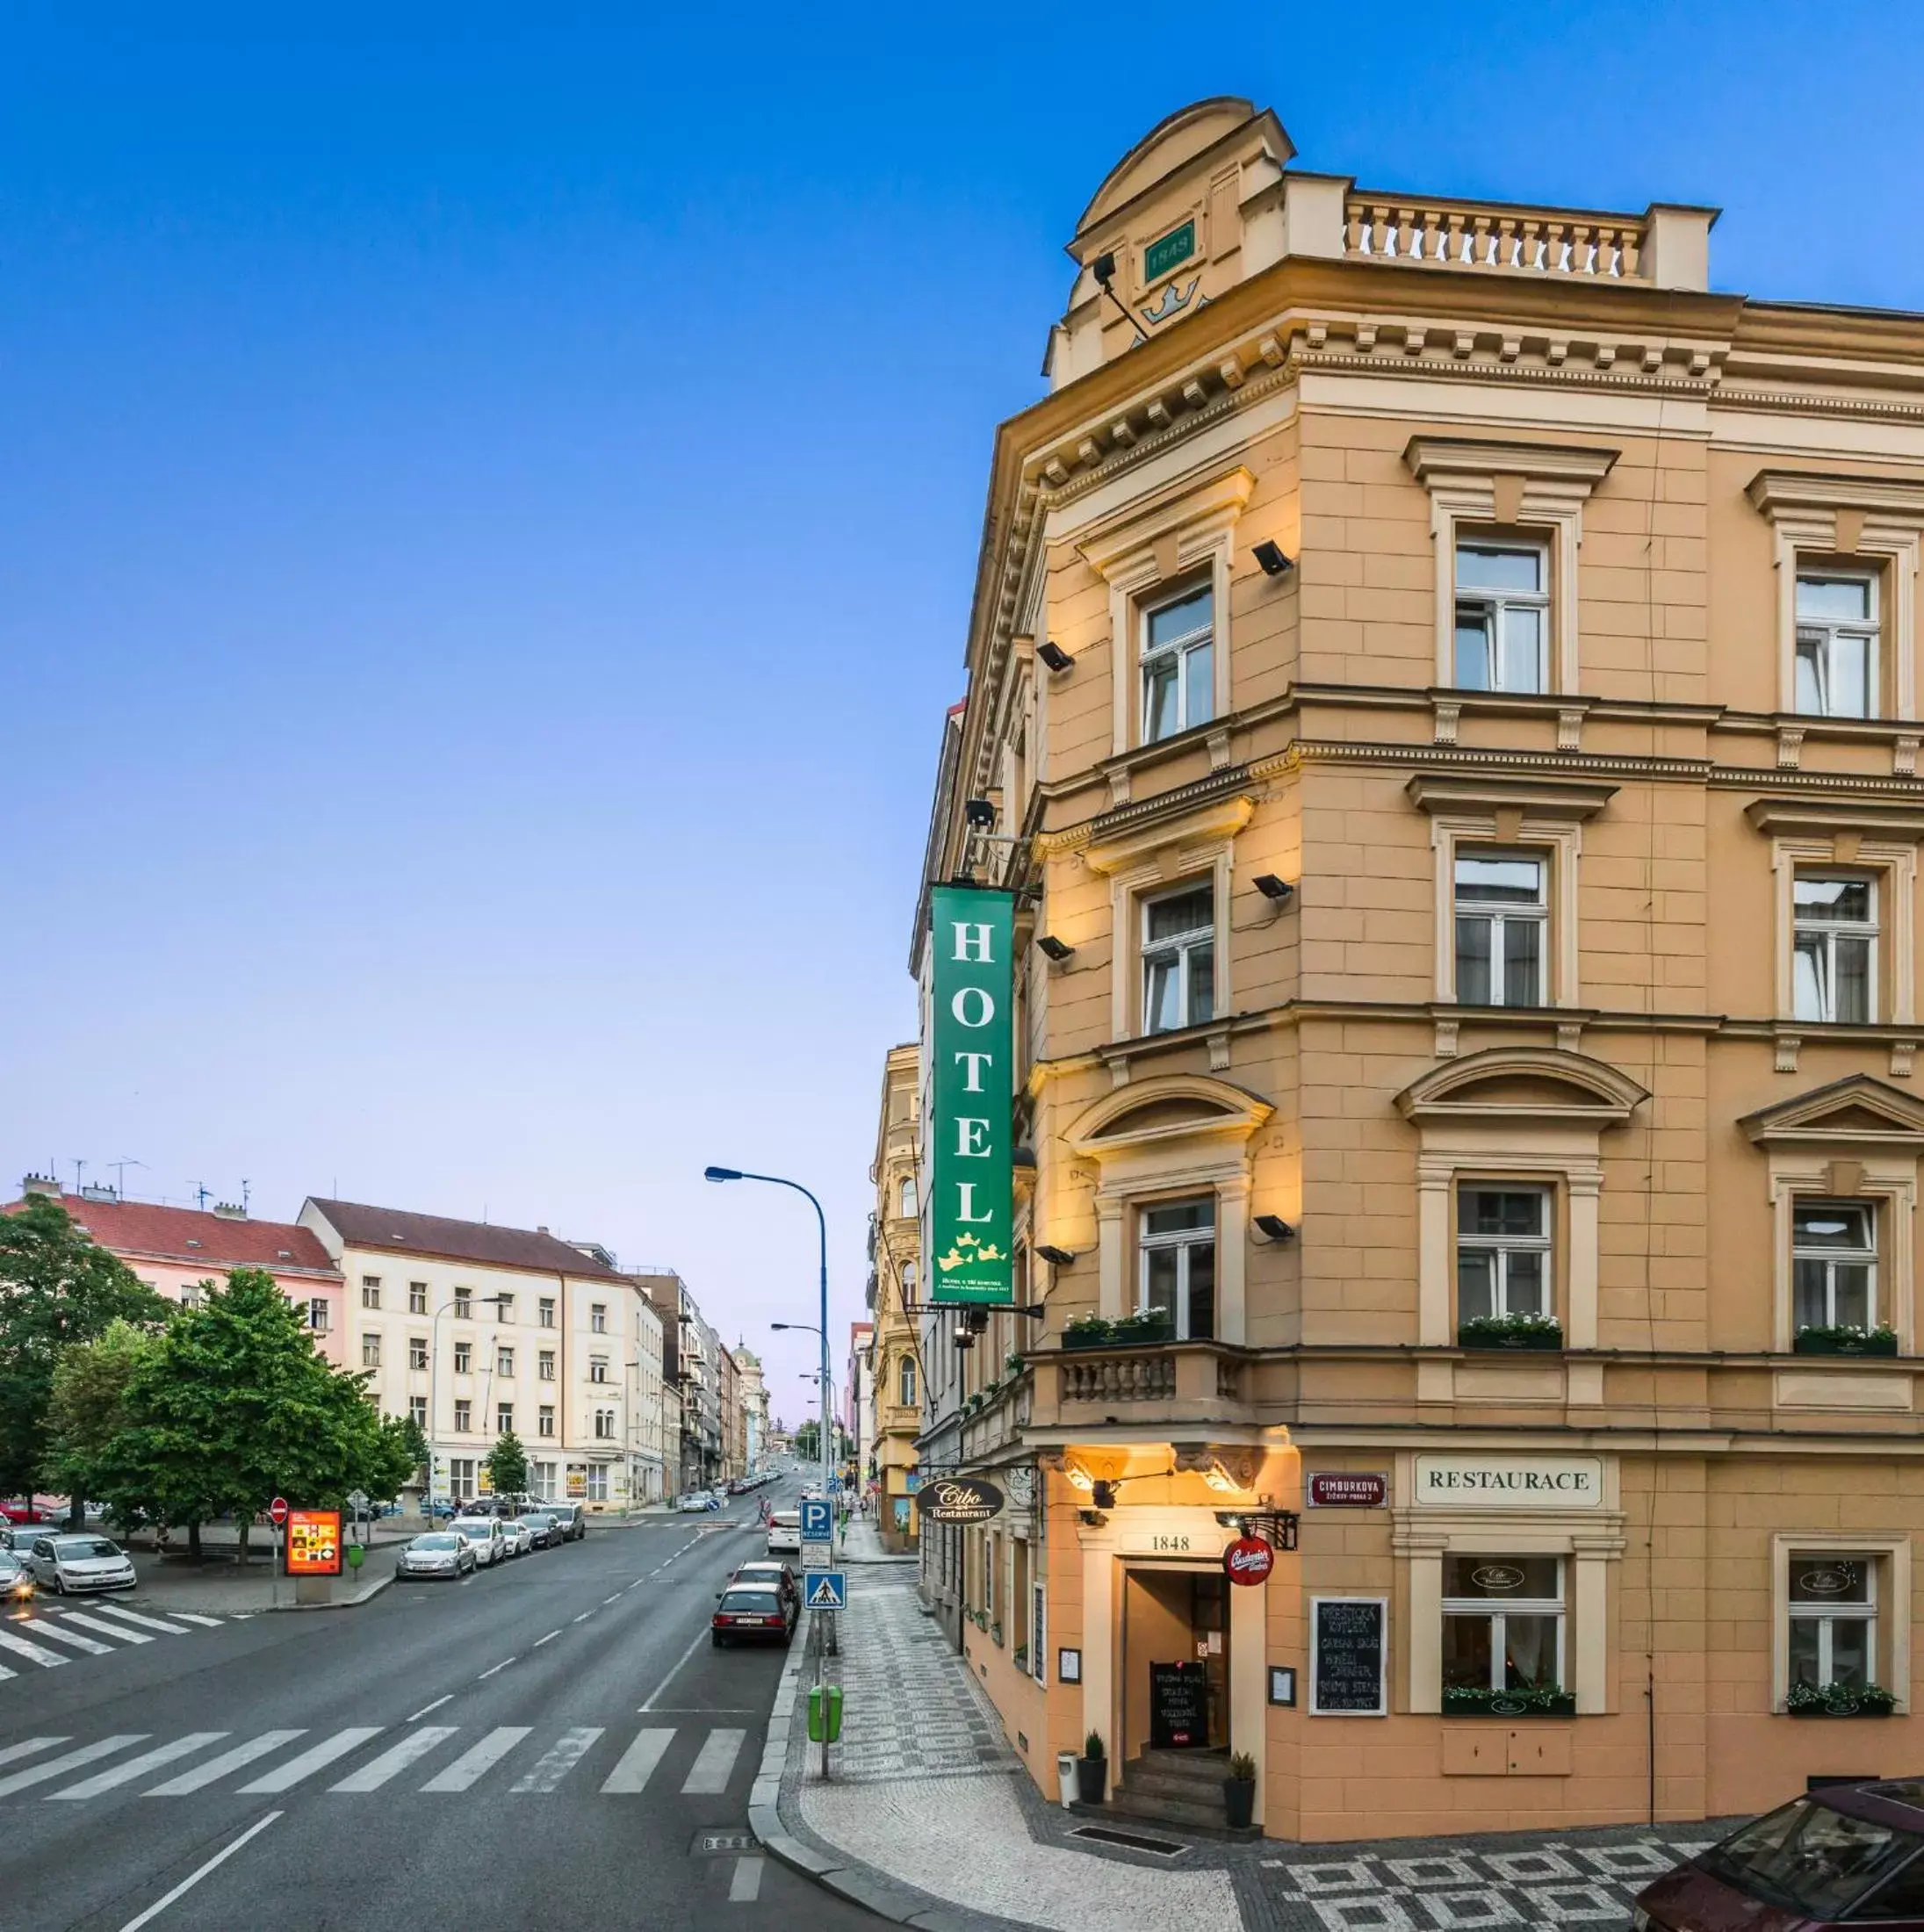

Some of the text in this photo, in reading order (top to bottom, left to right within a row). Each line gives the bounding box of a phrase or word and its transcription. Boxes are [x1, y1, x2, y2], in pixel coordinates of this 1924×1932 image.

[951, 922, 996, 1222] HOTEL
[1319, 1481, 1379, 1492] CIMBURKOVA
[1430, 1471, 1589, 1490] RESTAURACE
[934, 1481, 982, 1505] Cibo
[808, 1505, 825, 1529] P
[933, 1509, 991, 1518] Restaurant
[1153, 1535, 1190, 1551] 1848
